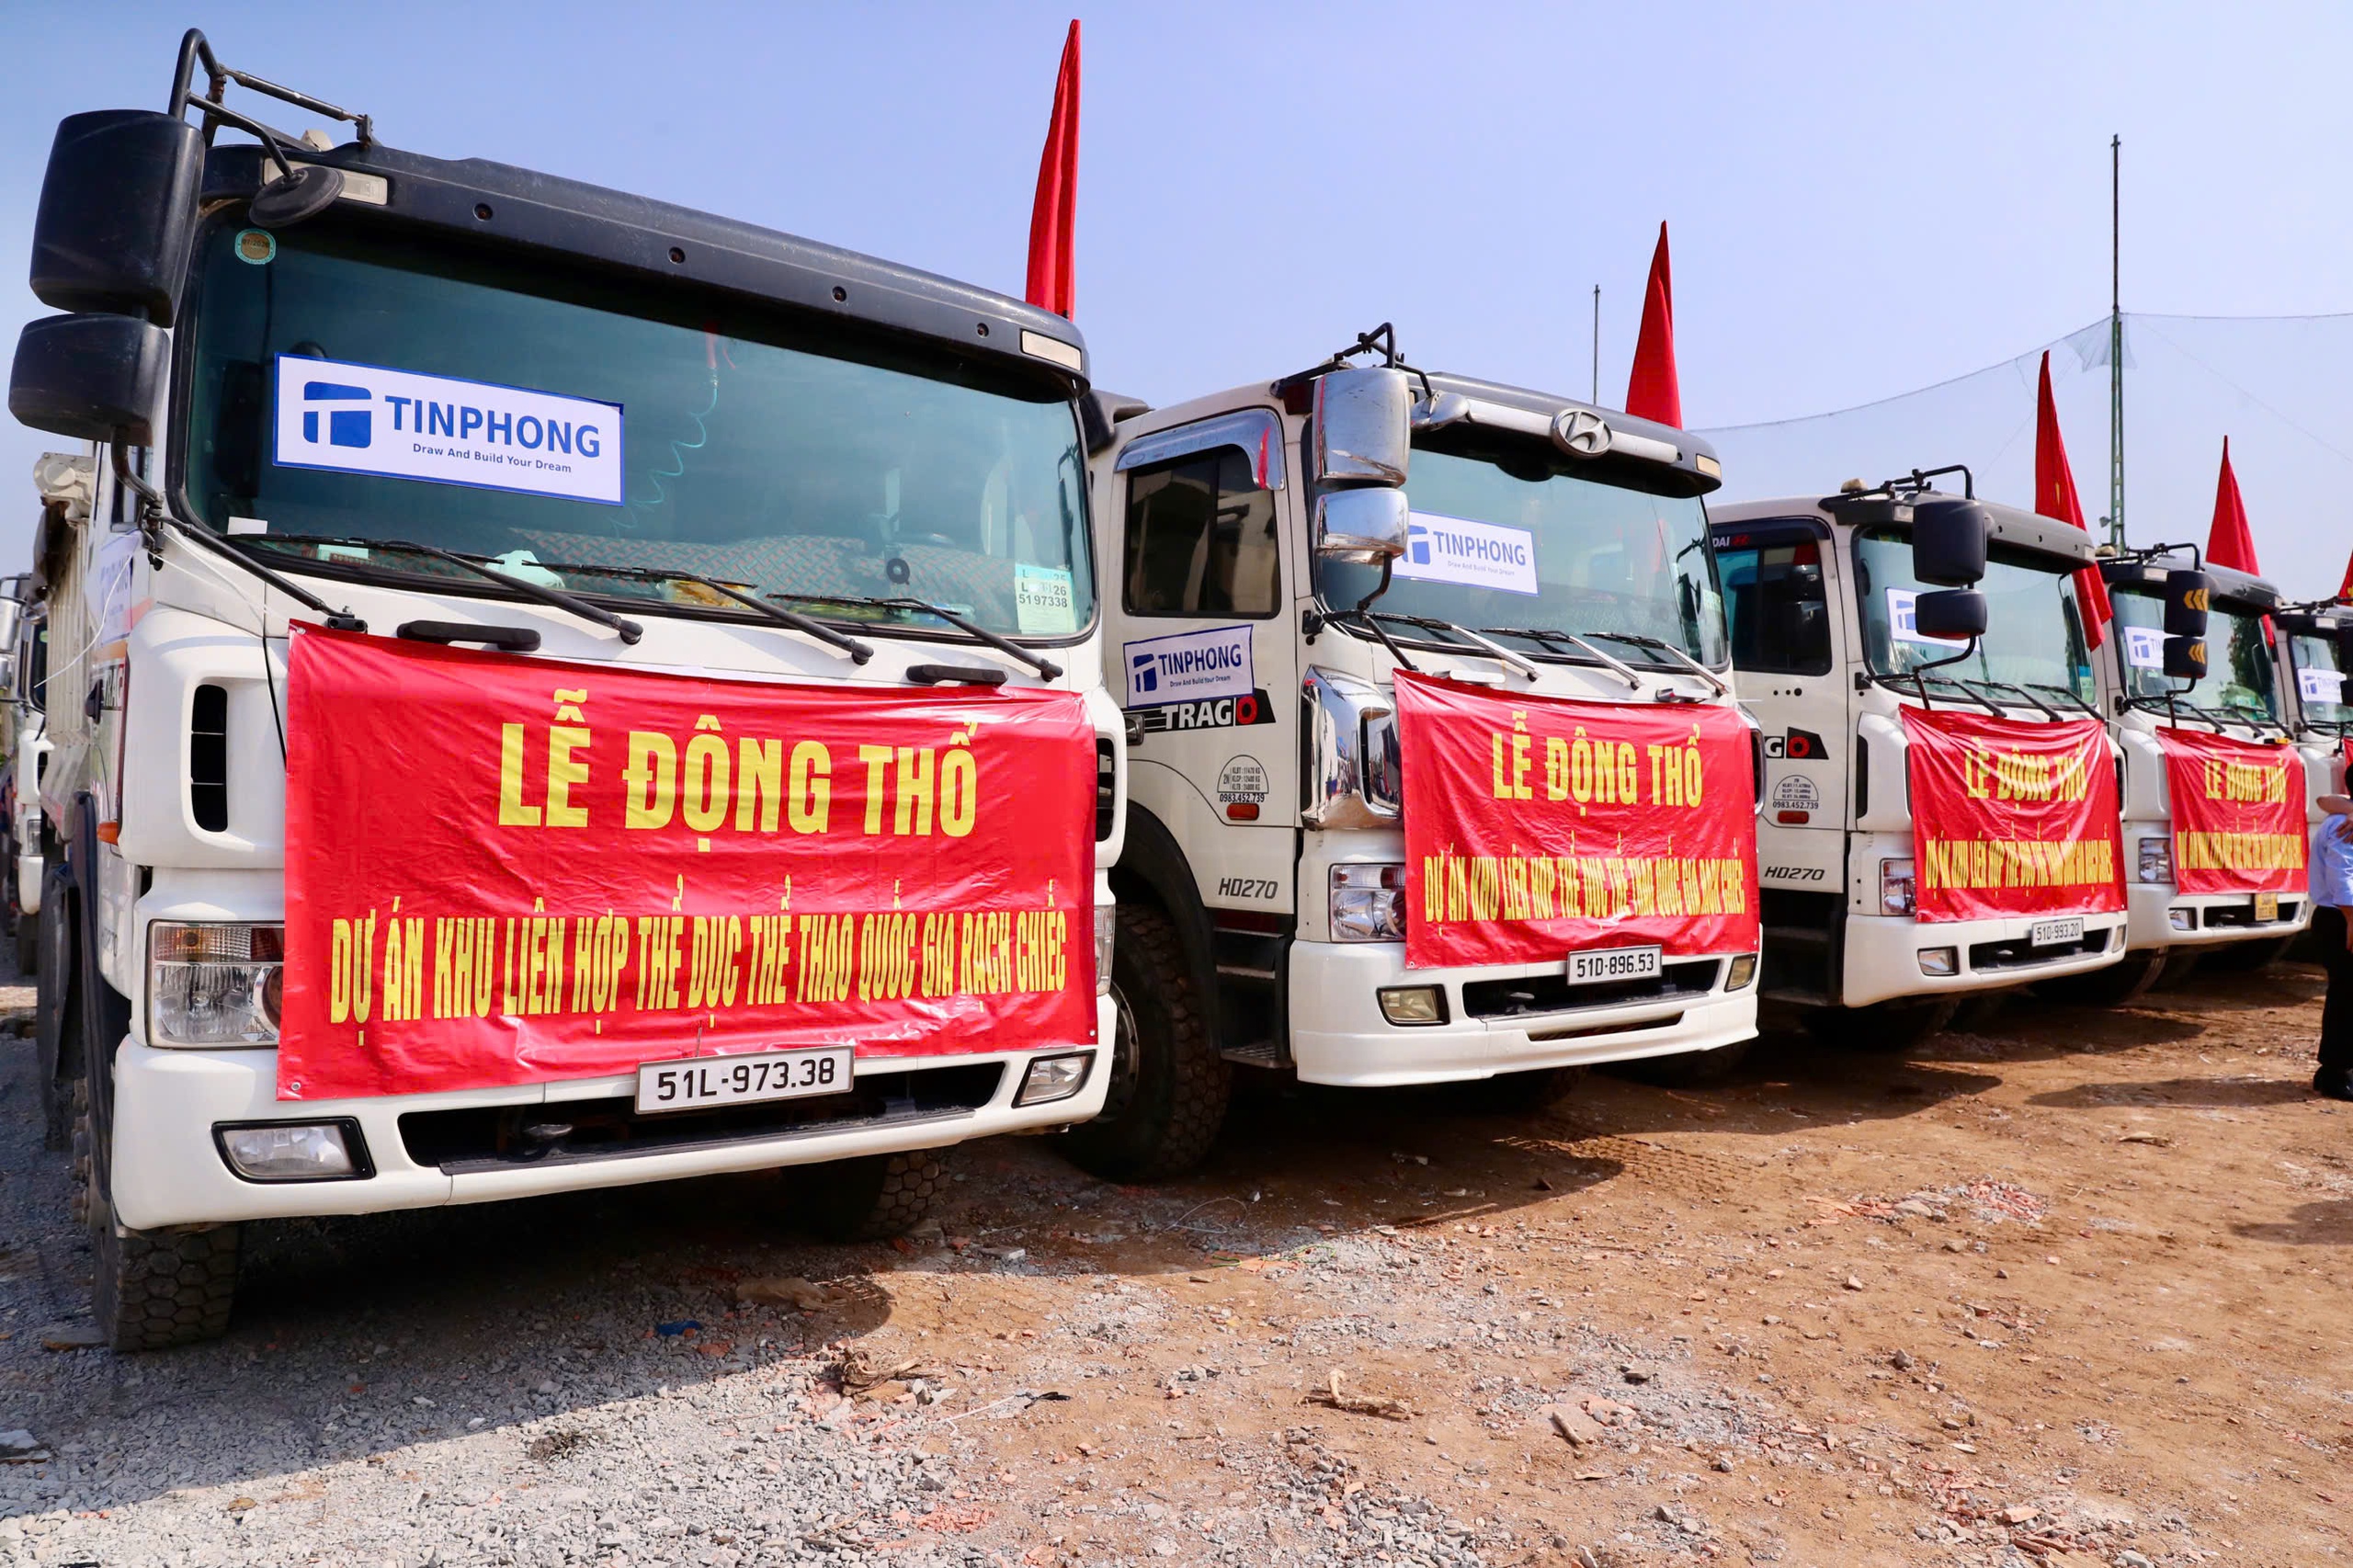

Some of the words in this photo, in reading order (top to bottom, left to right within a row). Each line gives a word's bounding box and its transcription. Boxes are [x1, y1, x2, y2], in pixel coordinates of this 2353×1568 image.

[384, 395, 600, 459] TINPHONG
[413, 443, 443, 456] Draw
[448, 446, 471, 459] And
[474, 449, 504, 464] Build
[506, 455, 532, 468] Your
[536, 459, 572, 473] Dream
[1433, 530, 1526, 566] TINPHONG
[1158, 644, 1242, 676] TINPHONG
[498, 688, 591, 828] LỄ
[622, 714, 832, 852] ĐỘNG
[859, 720, 978, 837] THỔ
[1492, 710, 1533, 801] LỄ
[1545, 726, 1638, 816] ĐỘNG
[1647, 723, 1703, 808] THỔ
[1218, 878, 1279, 899] HD270
[1424, 849, 1445, 937] DỰ
[1471, 857, 1499, 920] KHU
[1500, 843, 1531, 920] LIÊN
[1764, 866, 1825, 881] HD270
[330, 908, 376, 1046] DỰ
[382, 895, 424, 1021] ÁN
[434, 917, 495, 1019] KHU
[503, 896, 565, 1015] LIÊN
[572, 908, 629, 1034] HỢP
[636, 874, 684, 1011] THỂ
[688, 914, 742, 1028] DỤC
[746, 874, 792, 1006] THỂ
[797, 914, 854, 1003] THAO
[858, 879, 917, 1006] QUỐC
[921, 912, 954, 998] GIA
[961, 912, 1012, 1013] RẠCH
[1017, 879, 1067, 994] CHIẾC
[1577, 953, 1654, 978] 51D-896.53
[657, 1057, 835, 1101] 51L-973.38
